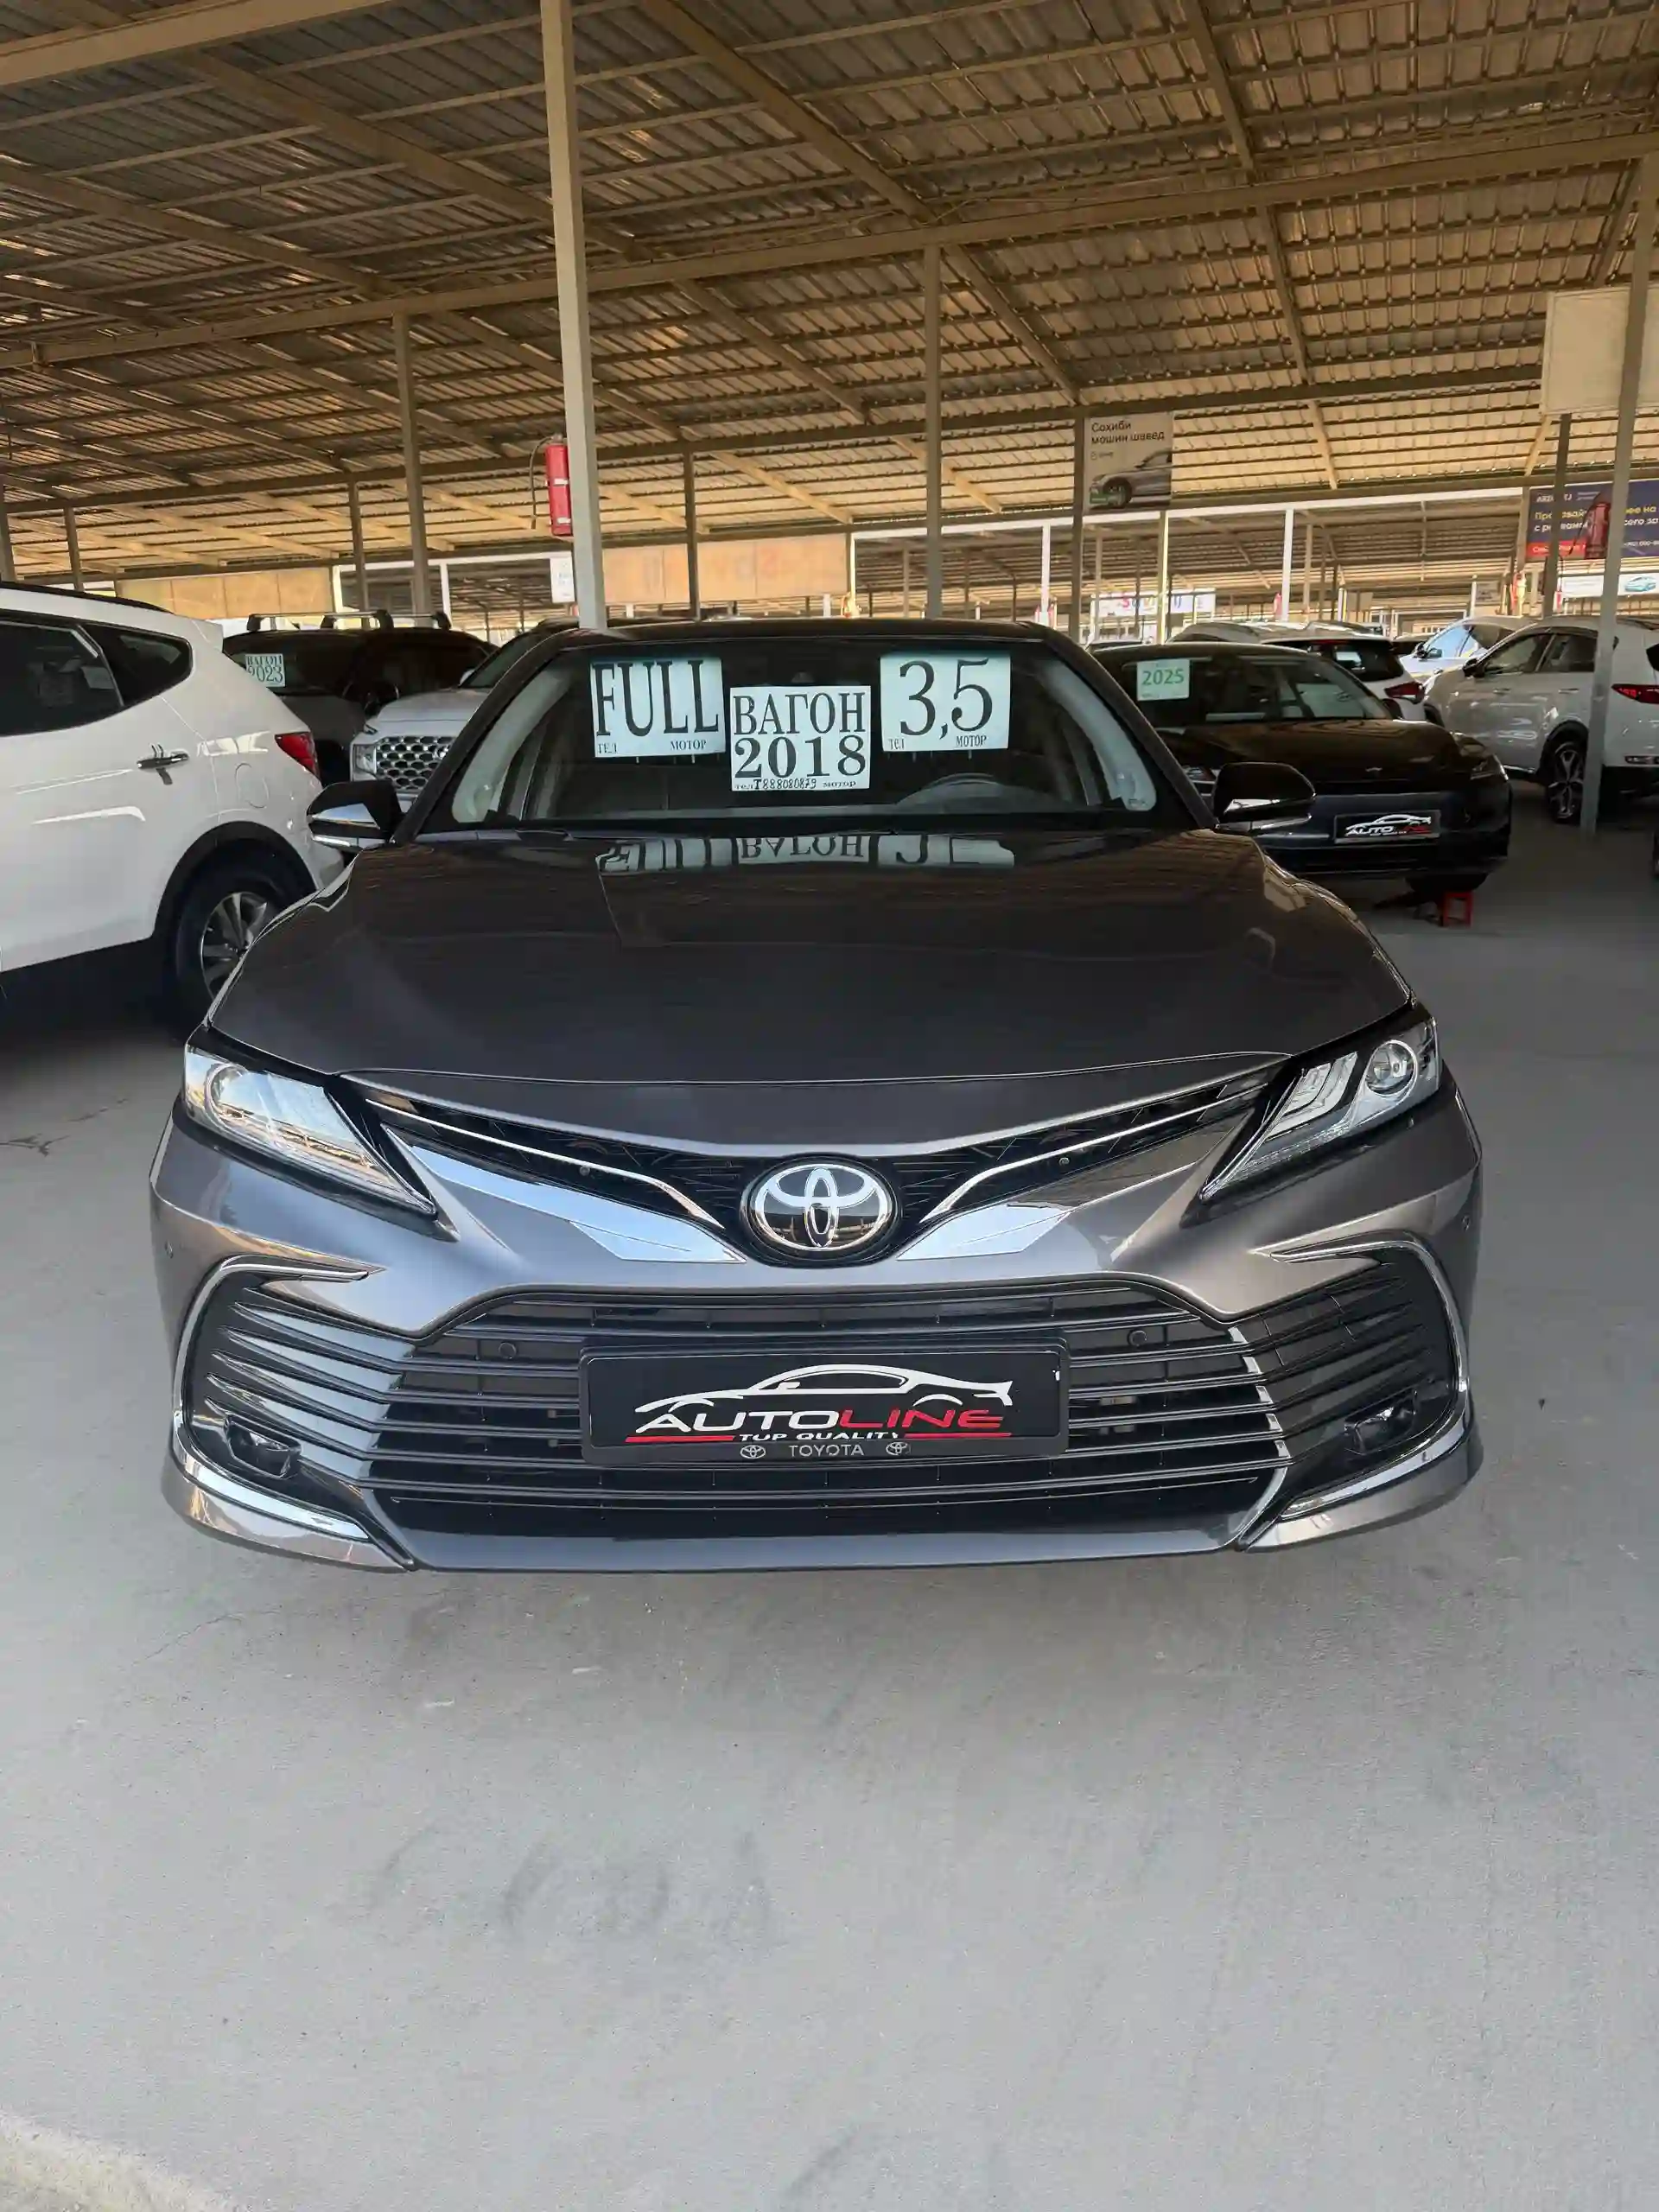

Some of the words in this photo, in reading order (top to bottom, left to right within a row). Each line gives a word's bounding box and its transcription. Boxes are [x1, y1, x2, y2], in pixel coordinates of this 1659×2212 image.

[1141, 668, 1185, 685] 2025
[592, 659, 719, 737] FULL
[899, 658, 993, 740] 3,5
[733, 692, 866, 734] ВАГОН
[670, 739, 707, 751] МОТОР
[956, 734, 987, 747] МОТОР
[734, 734, 866, 779] 2018
[635, 1408, 1004, 1433] AUTOLINE
[789, 1444, 864, 1457] TOYOTA
